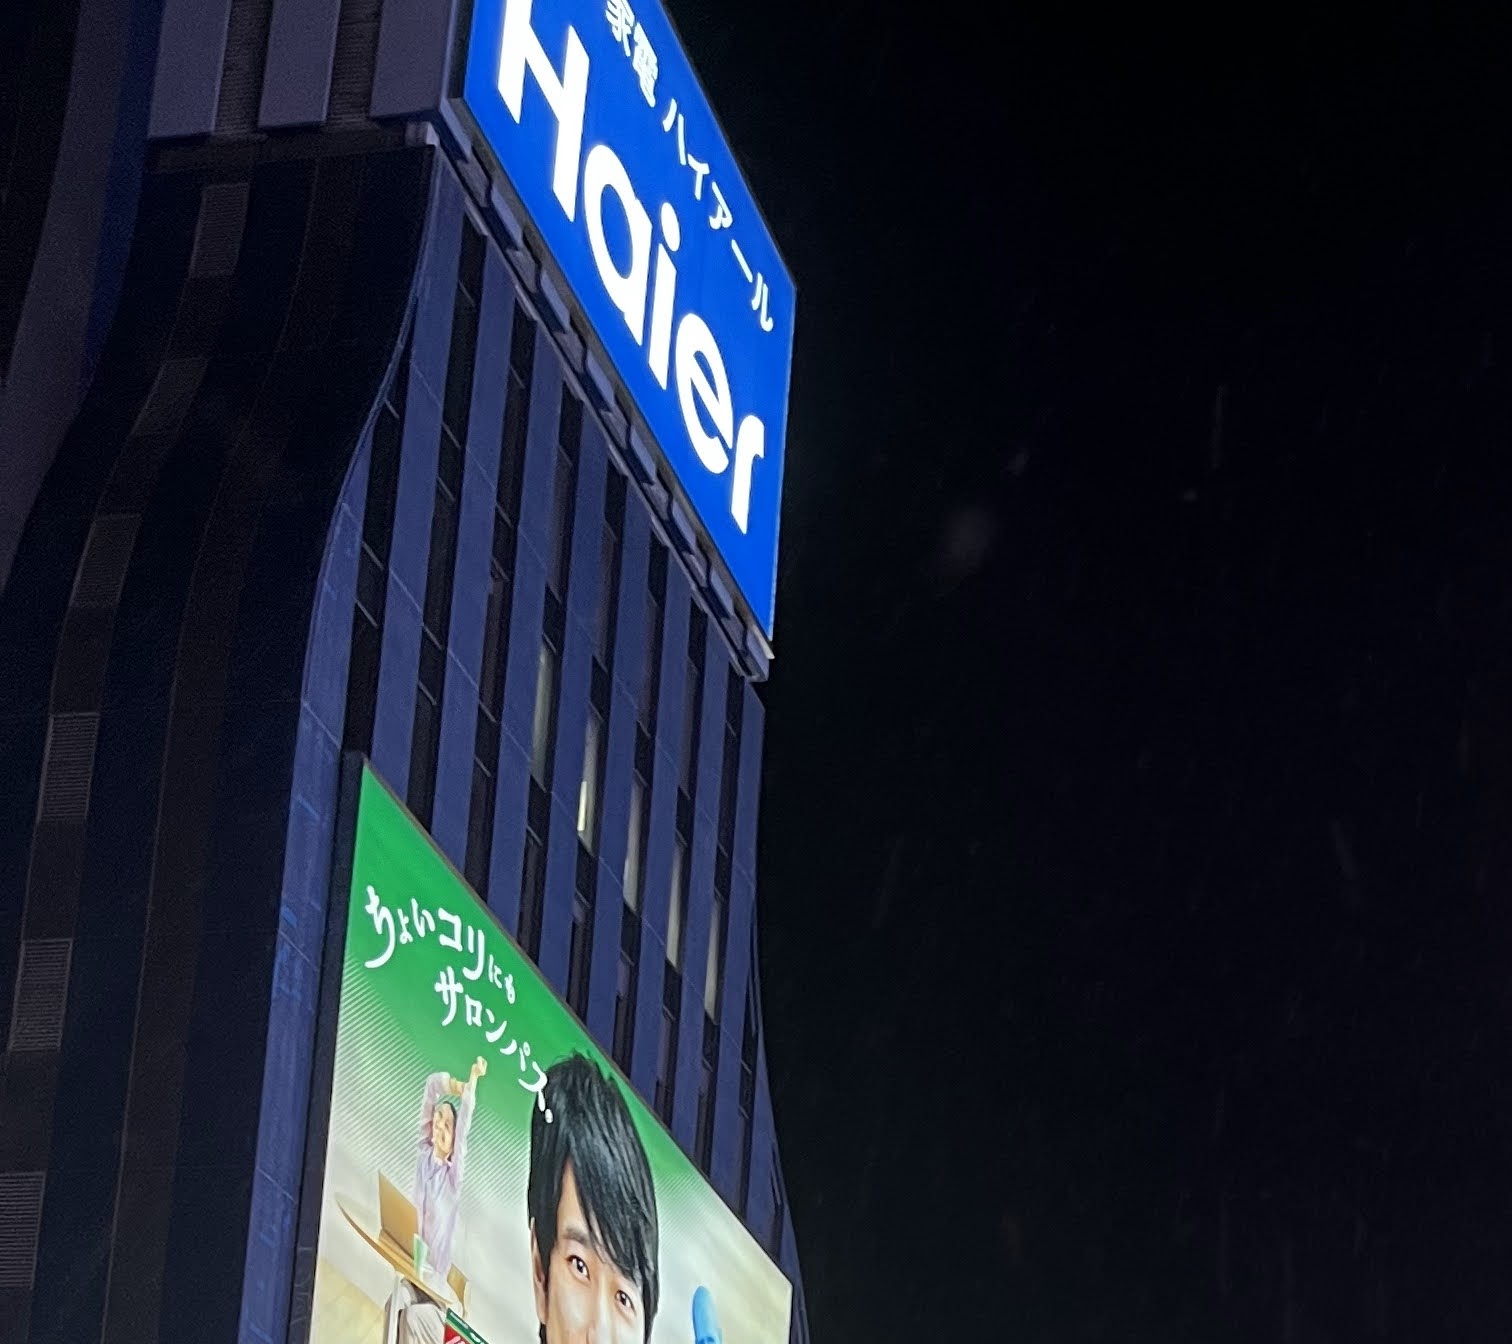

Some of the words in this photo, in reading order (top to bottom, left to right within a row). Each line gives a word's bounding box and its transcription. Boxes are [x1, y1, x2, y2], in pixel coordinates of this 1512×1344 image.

[497, 0, 765, 534] Haier
[364, 884, 516, 1005] ちょいコリにも
